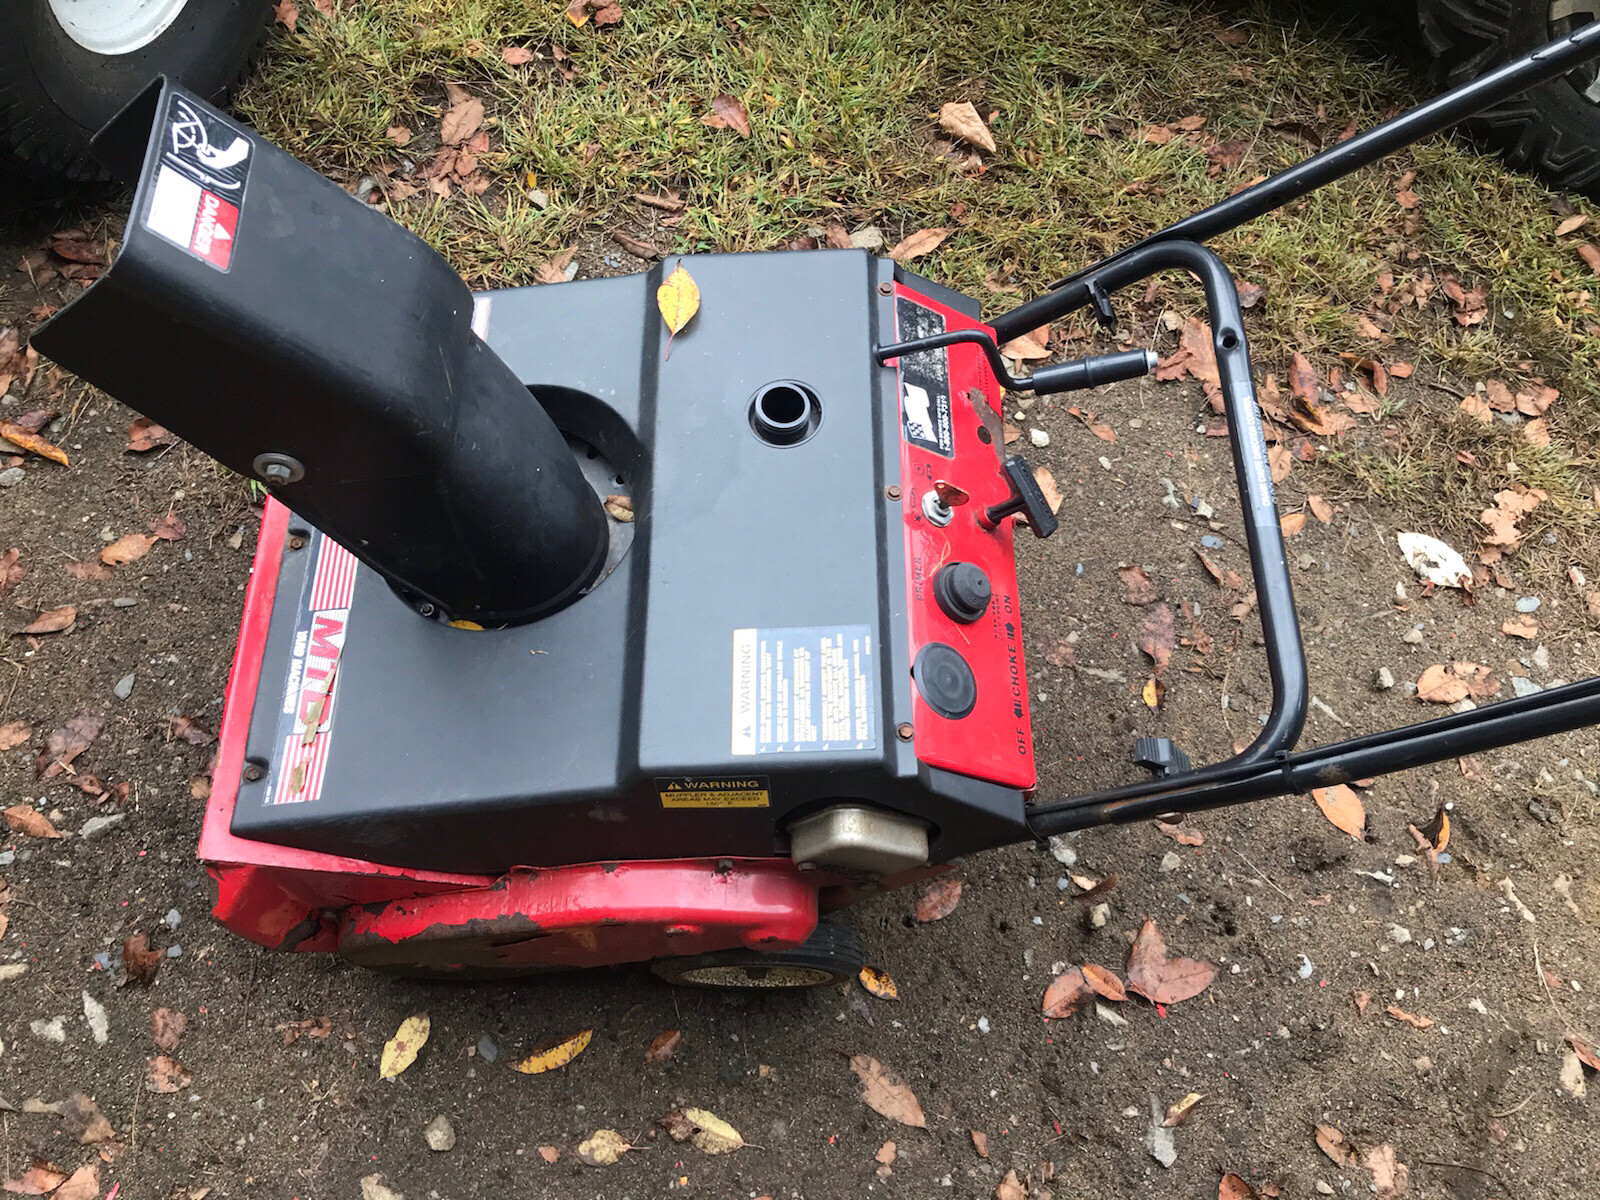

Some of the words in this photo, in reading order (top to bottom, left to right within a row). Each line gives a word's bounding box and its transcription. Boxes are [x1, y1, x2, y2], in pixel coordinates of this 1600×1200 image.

[194, 193, 220, 255] DANGER
[914, 557, 924, 601] PRIMER
[1003, 595, 1012, 614] ON
[293, 630, 308, 657] YARD
[282, 658, 304, 715] MACHINES
[740, 643, 751, 714] WARNING
[1008, 644, 1021, 697] CHOKE
[1015, 726, 1027, 755] OFF
[683, 780, 760, 789] WARNING
